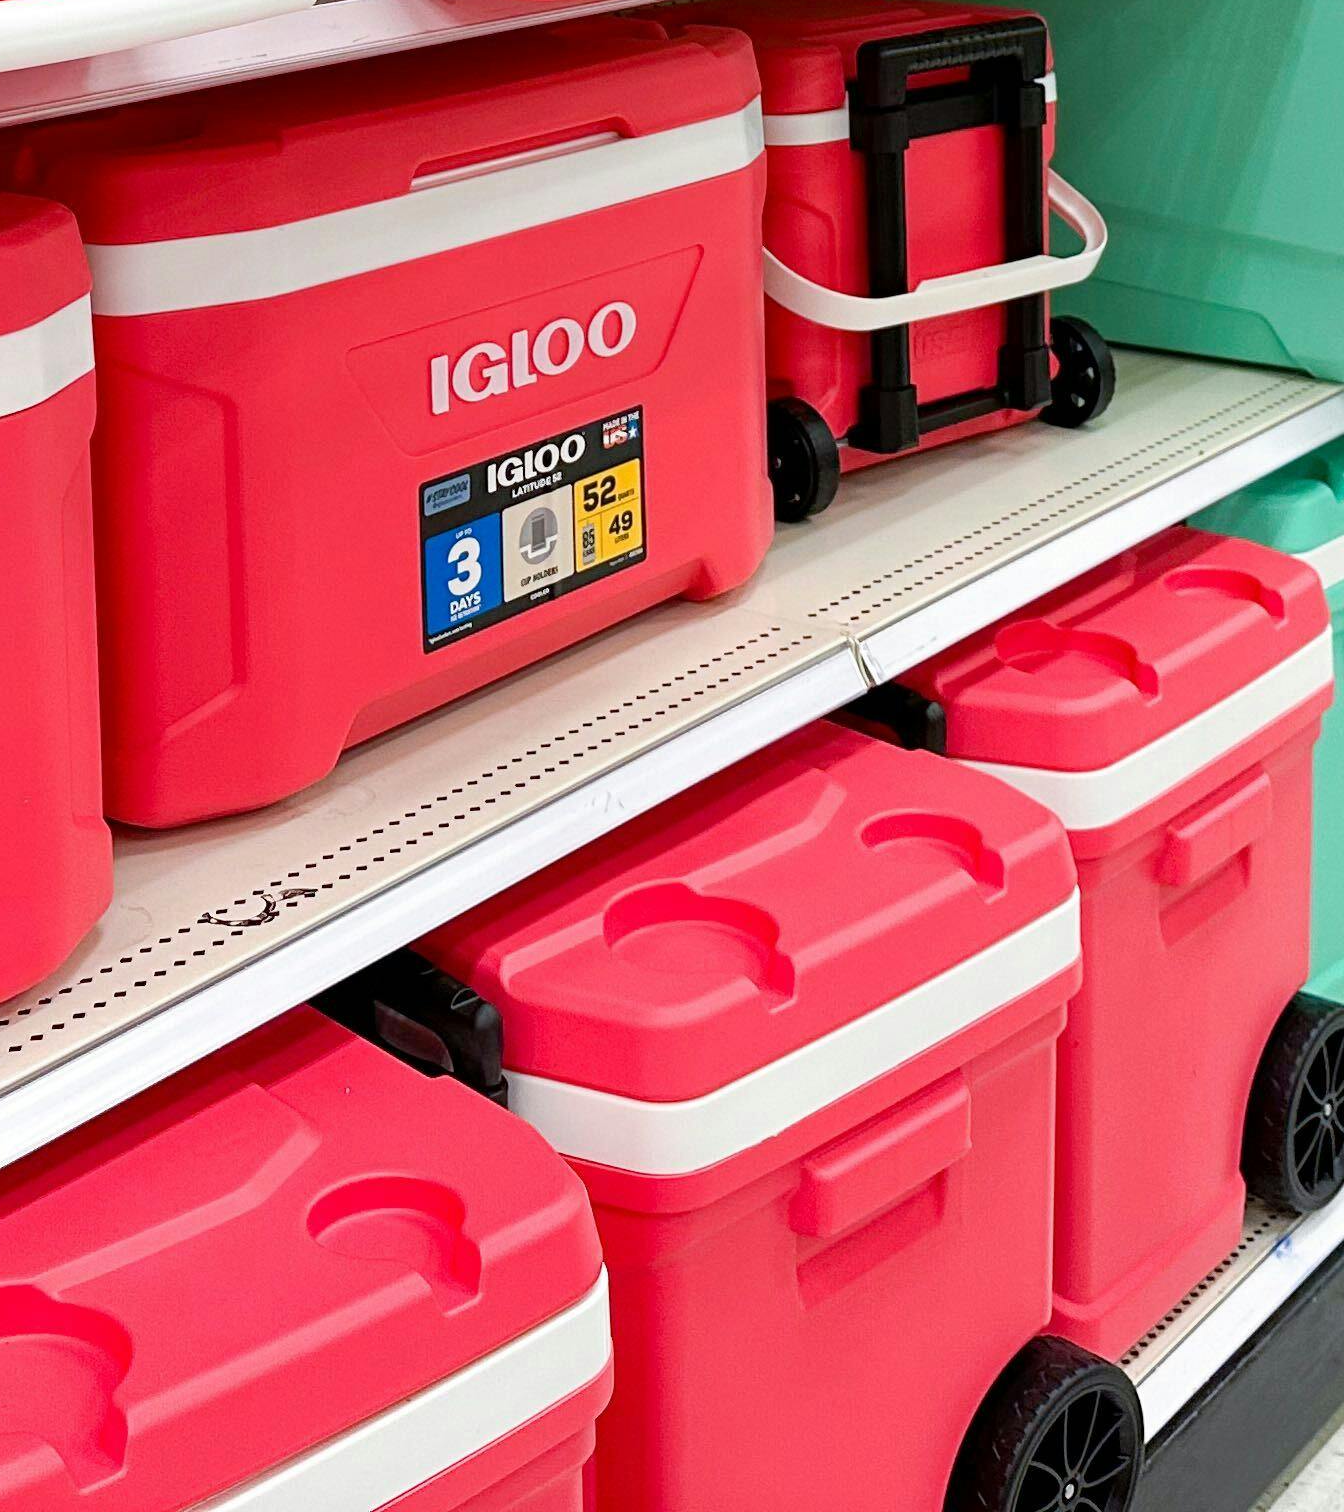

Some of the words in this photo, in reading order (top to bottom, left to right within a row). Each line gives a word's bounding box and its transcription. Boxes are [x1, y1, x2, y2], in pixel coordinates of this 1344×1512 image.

[431, 301, 637, 415] IGLOO
[487, 434, 586, 494] IGLOO
[512, 476, 552, 498] LATITUDE
[583, 475, 617, 512] 52
[609, 510, 633, 535] 49
[448, 537, 482, 596] 3
[450, 591, 481, 615] DAYS
